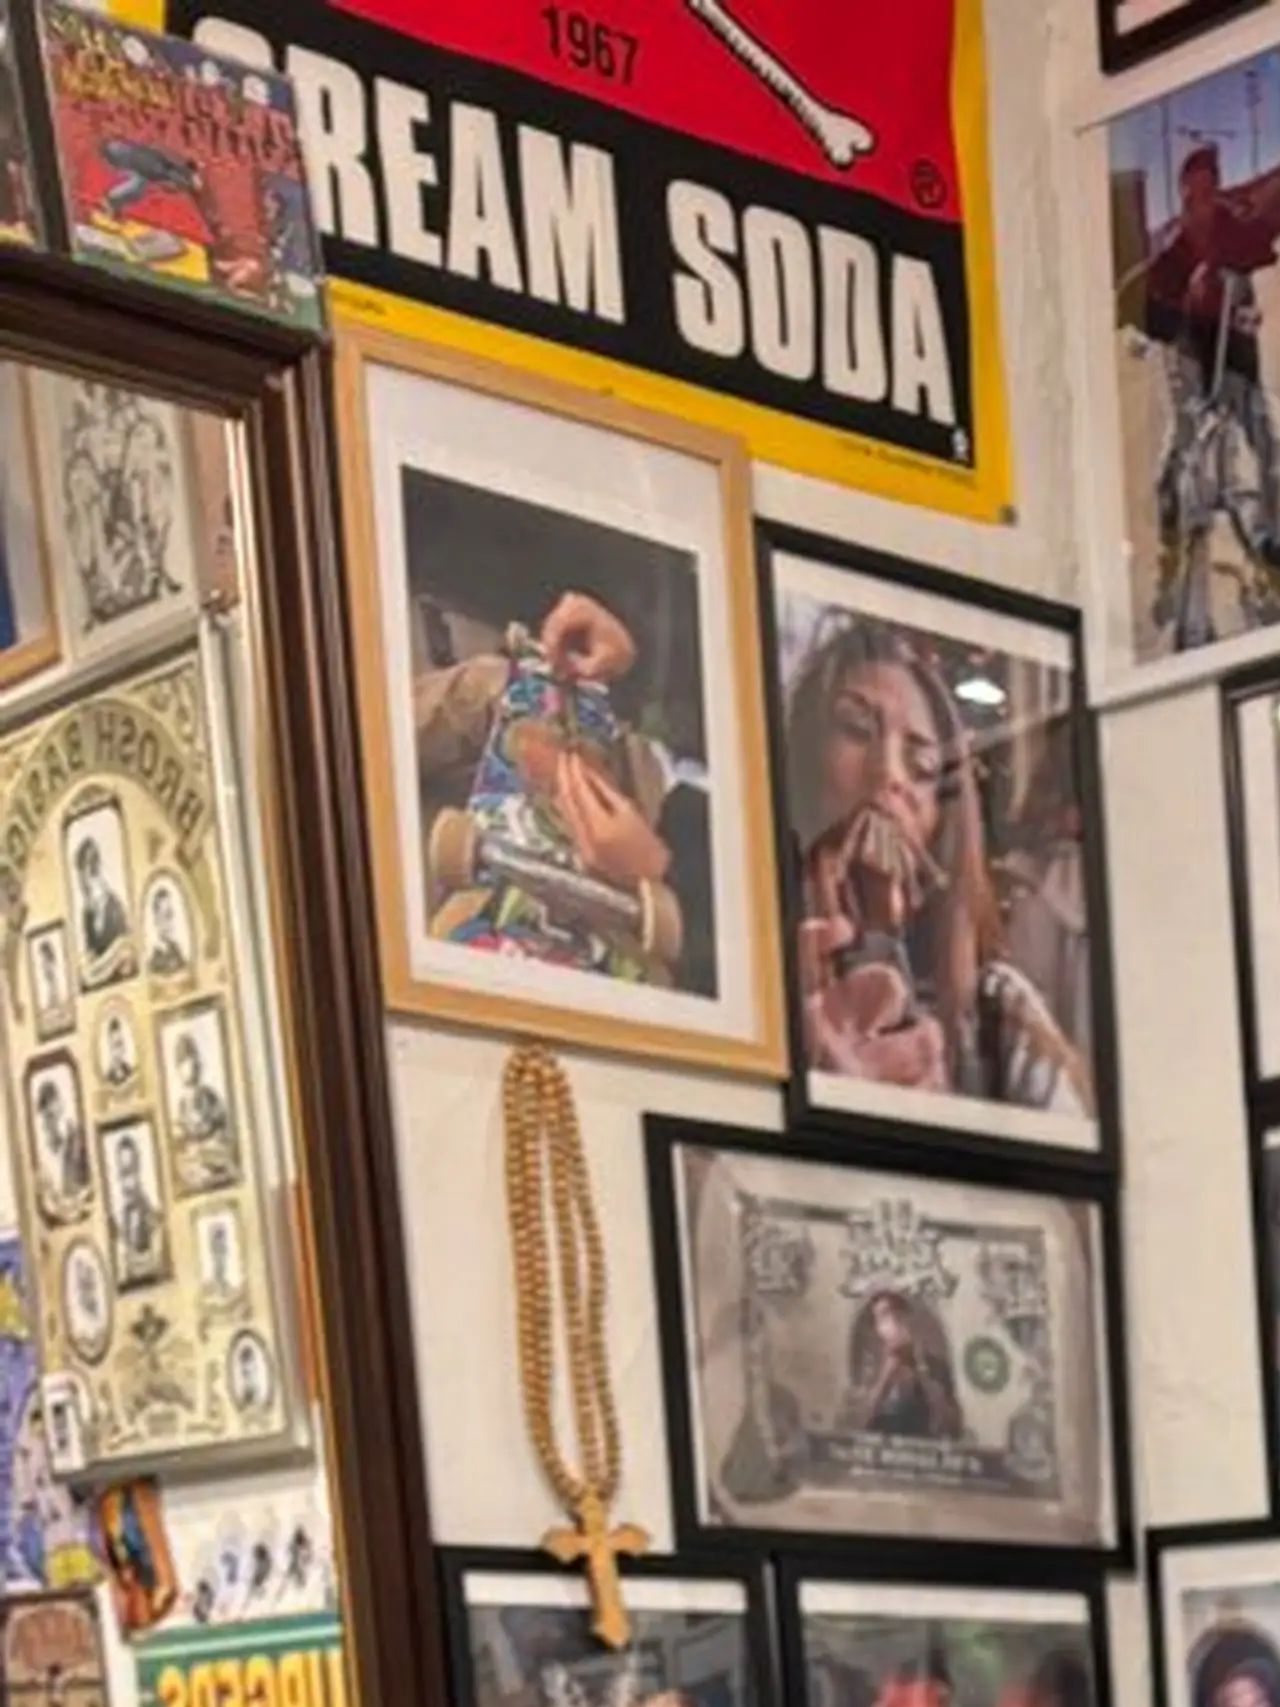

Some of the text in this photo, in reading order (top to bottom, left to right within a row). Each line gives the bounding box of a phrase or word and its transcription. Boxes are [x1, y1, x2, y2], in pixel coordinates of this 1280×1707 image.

[542, 6, 640, 84] 1967
[193, 17, 960, 427] REAM SODA
